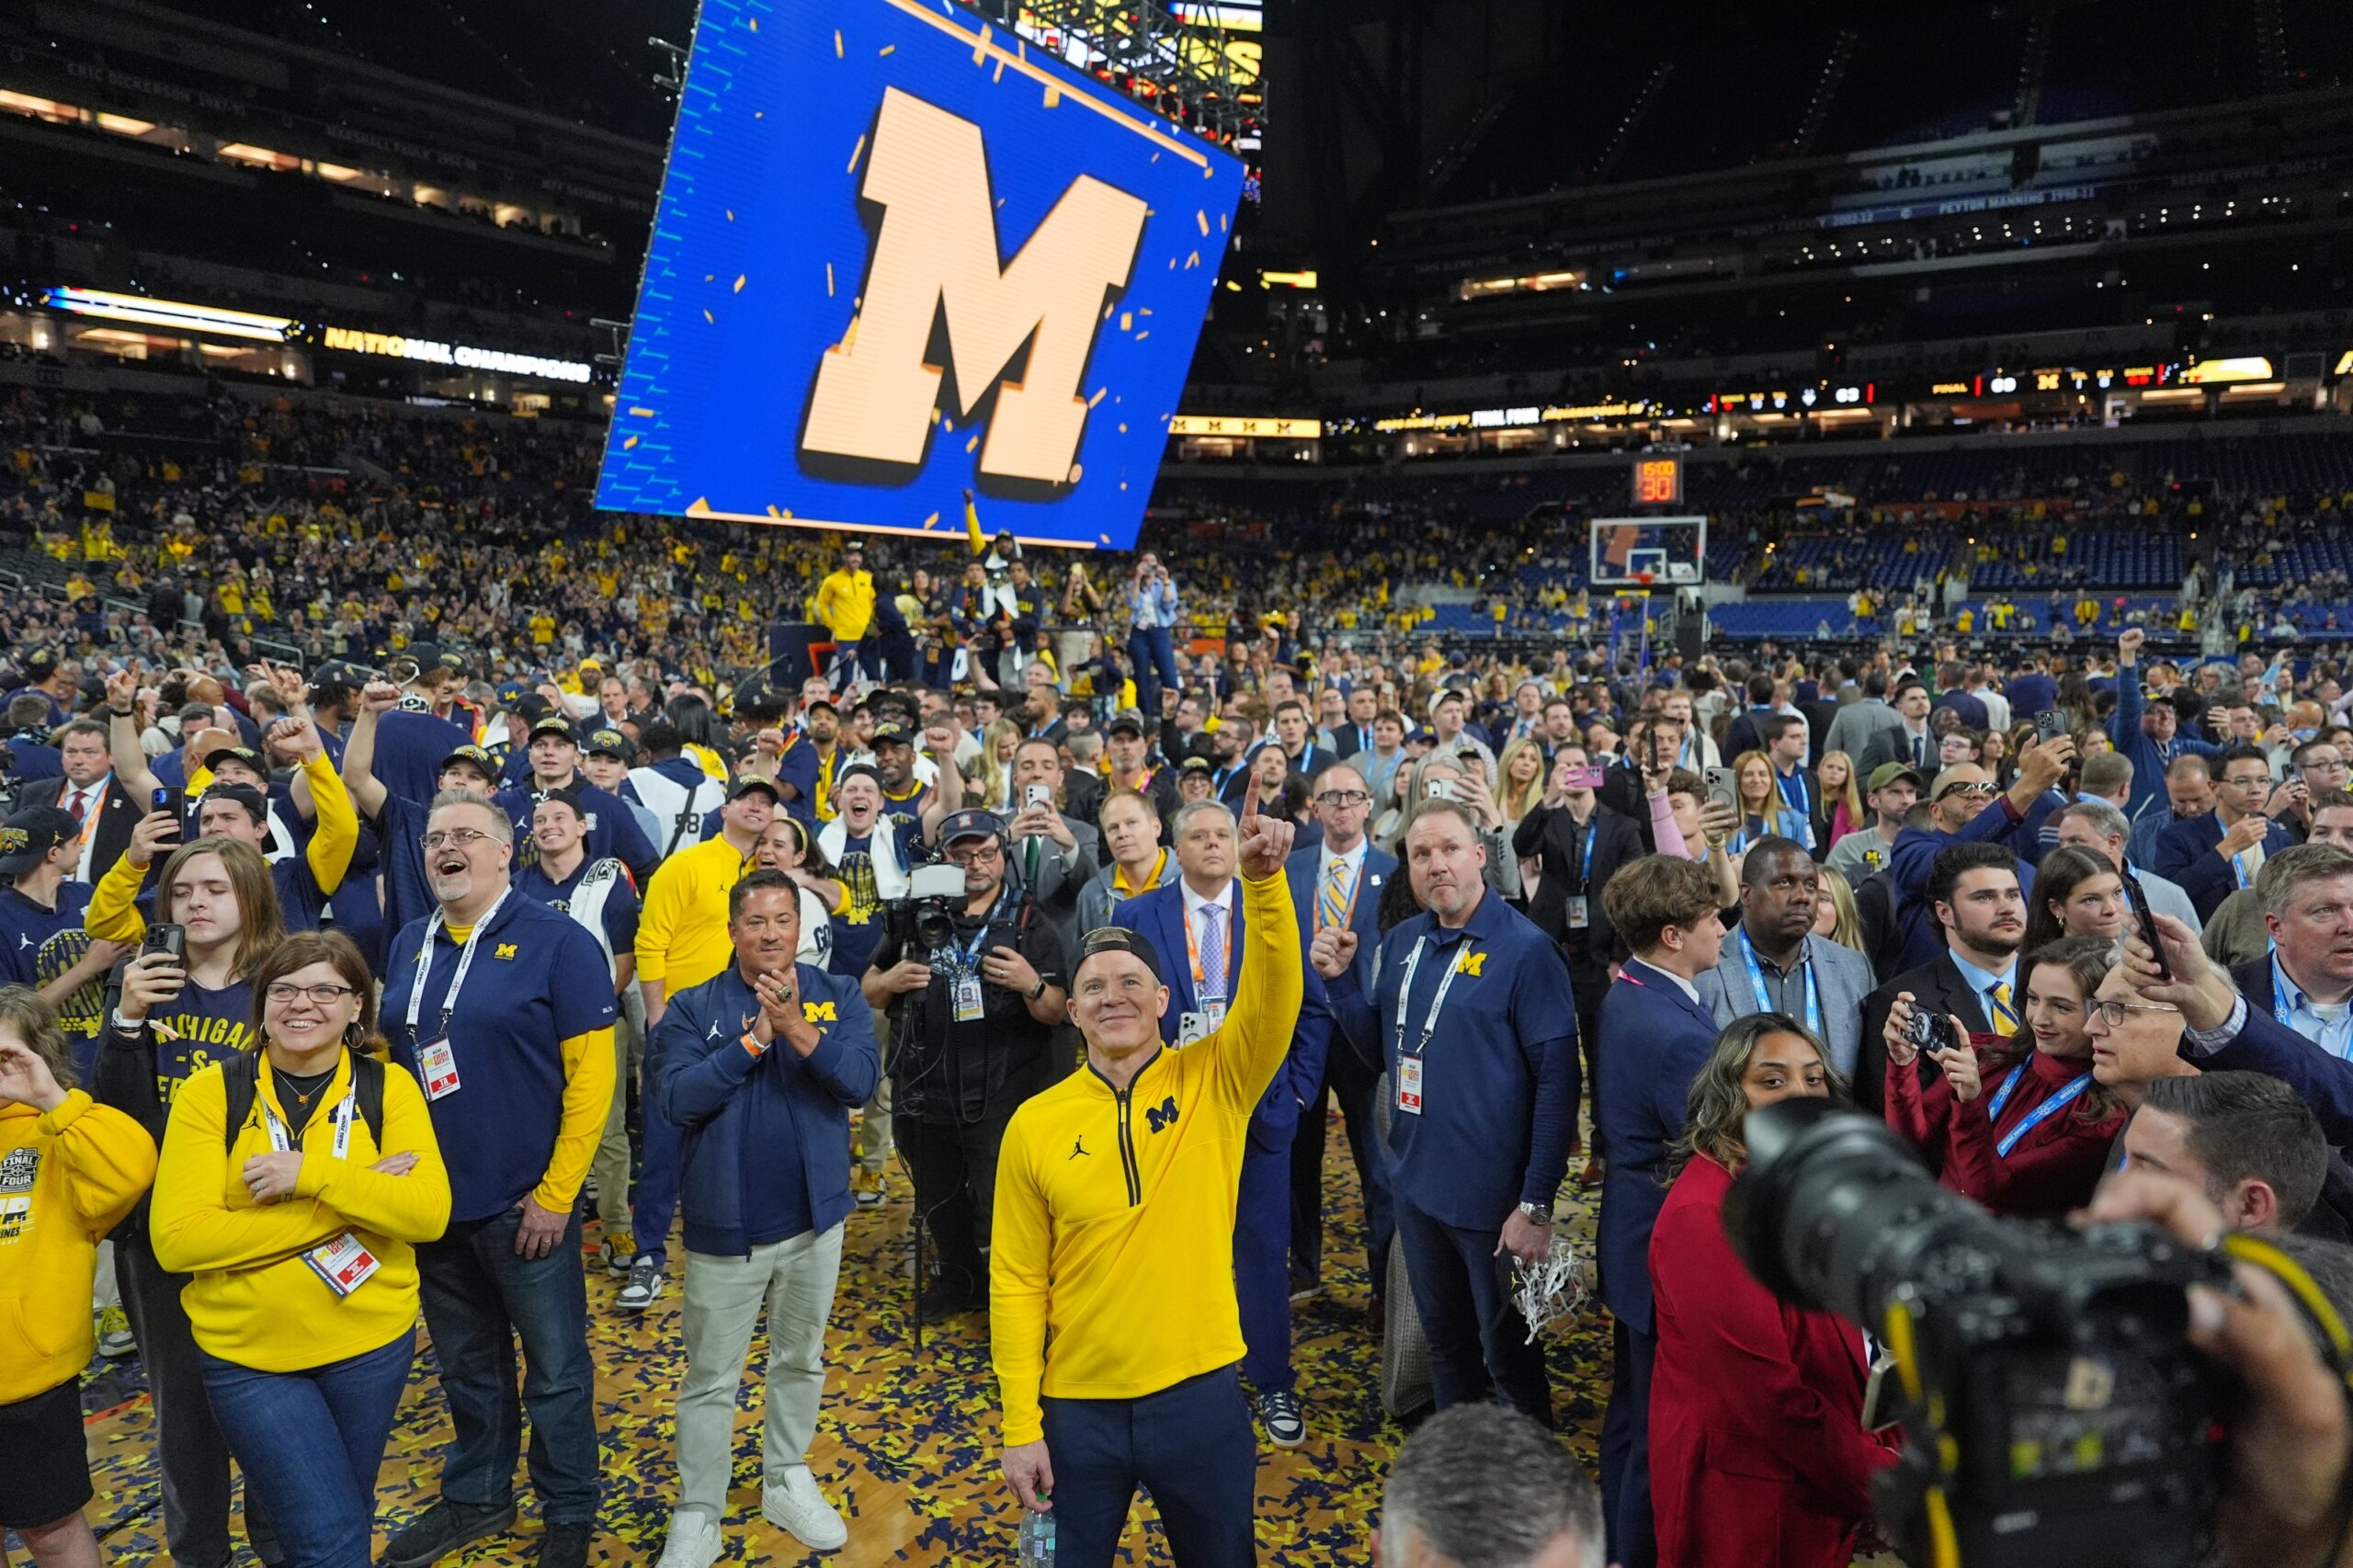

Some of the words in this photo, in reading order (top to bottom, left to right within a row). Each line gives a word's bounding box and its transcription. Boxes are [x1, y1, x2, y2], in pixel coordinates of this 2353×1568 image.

[1938, 197, 1985, 215] PEYTON
[1989, 191, 2045, 209] MANNING
[802, 85, 1148, 483] M
[324, 326, 454, 365] NATIONAL
[454, 345, 592, 383] CHAMPIONS
[1472, 409, 1506, 427] FINAL
[1506, 407, 1540, 426] FOUR
[1642, 476, 1671, 502] 30
[847, 906, 870, 926] M
[494, 943, 518, 958] M
[1456, 951, 1488, 977] M
[802, 1001, 838, 1023] M
[1145, 1096, 1180, 1134] M
[337, 1131, 346, 1149] FINAL
[4, 1155, 34, 1168] FINAL
[2, 1175, 32, 1187] FOUR
